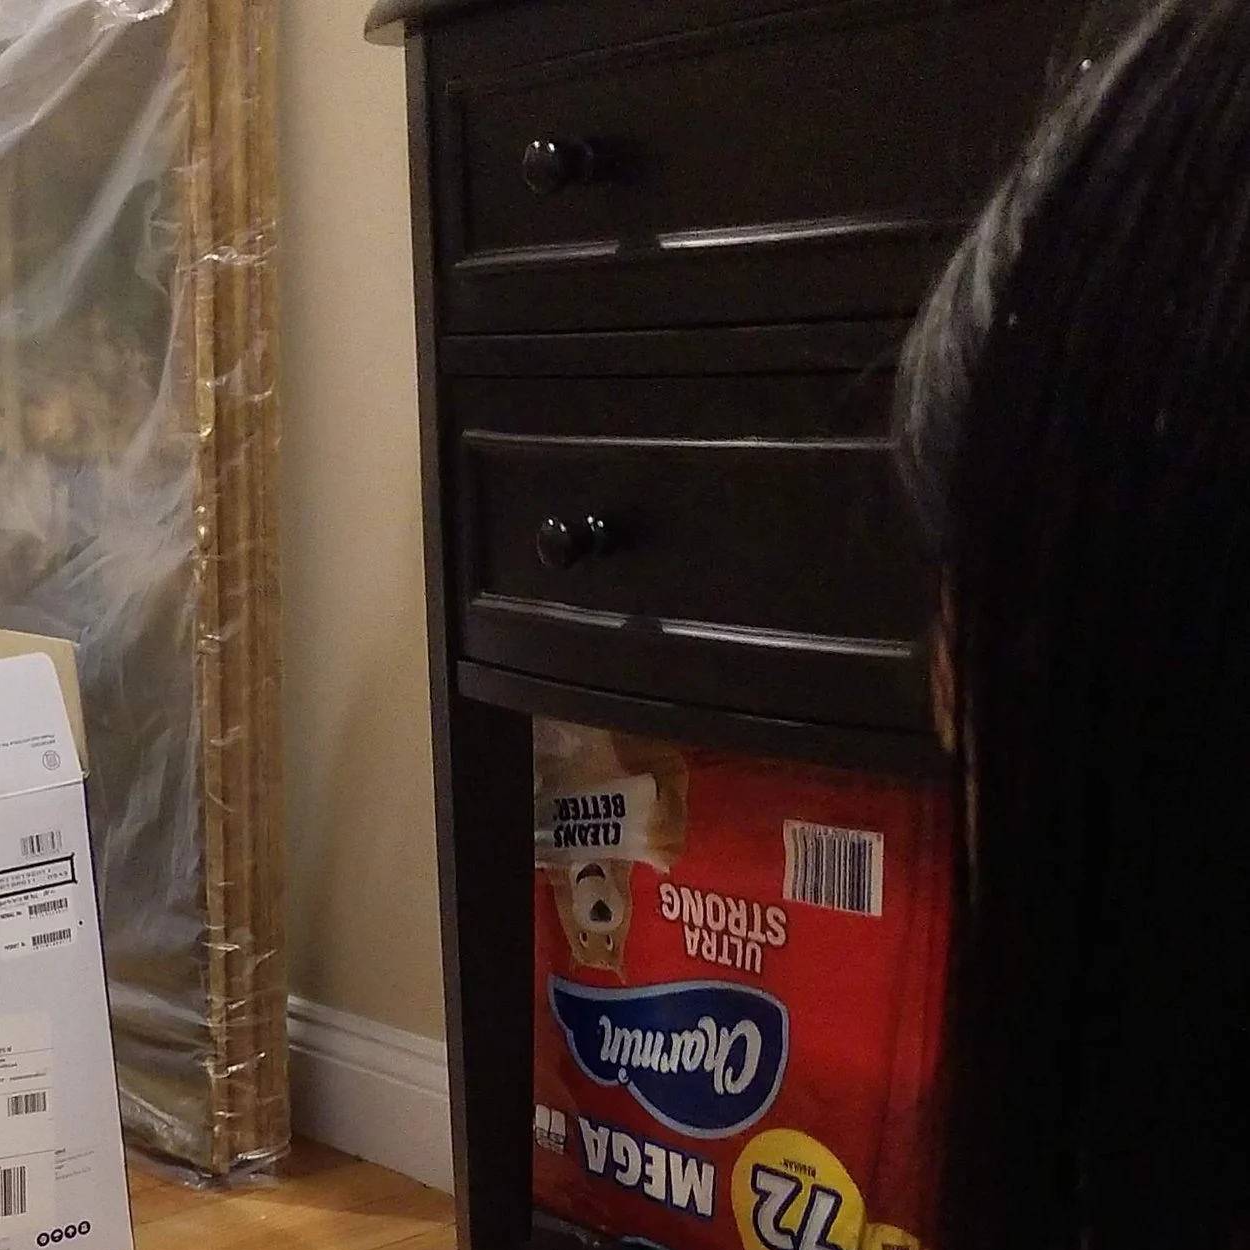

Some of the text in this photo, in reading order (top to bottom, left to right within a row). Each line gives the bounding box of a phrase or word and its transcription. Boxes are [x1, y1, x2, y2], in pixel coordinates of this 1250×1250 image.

[553, 821, 622, 849] CLEANS
[659, 883, 787, 946] STRONG
[684, 925, 762, 973] ULTRA
[599, 1014, 762, 1095] Charmin
[578, 1114, 716, 1217] MEGA
